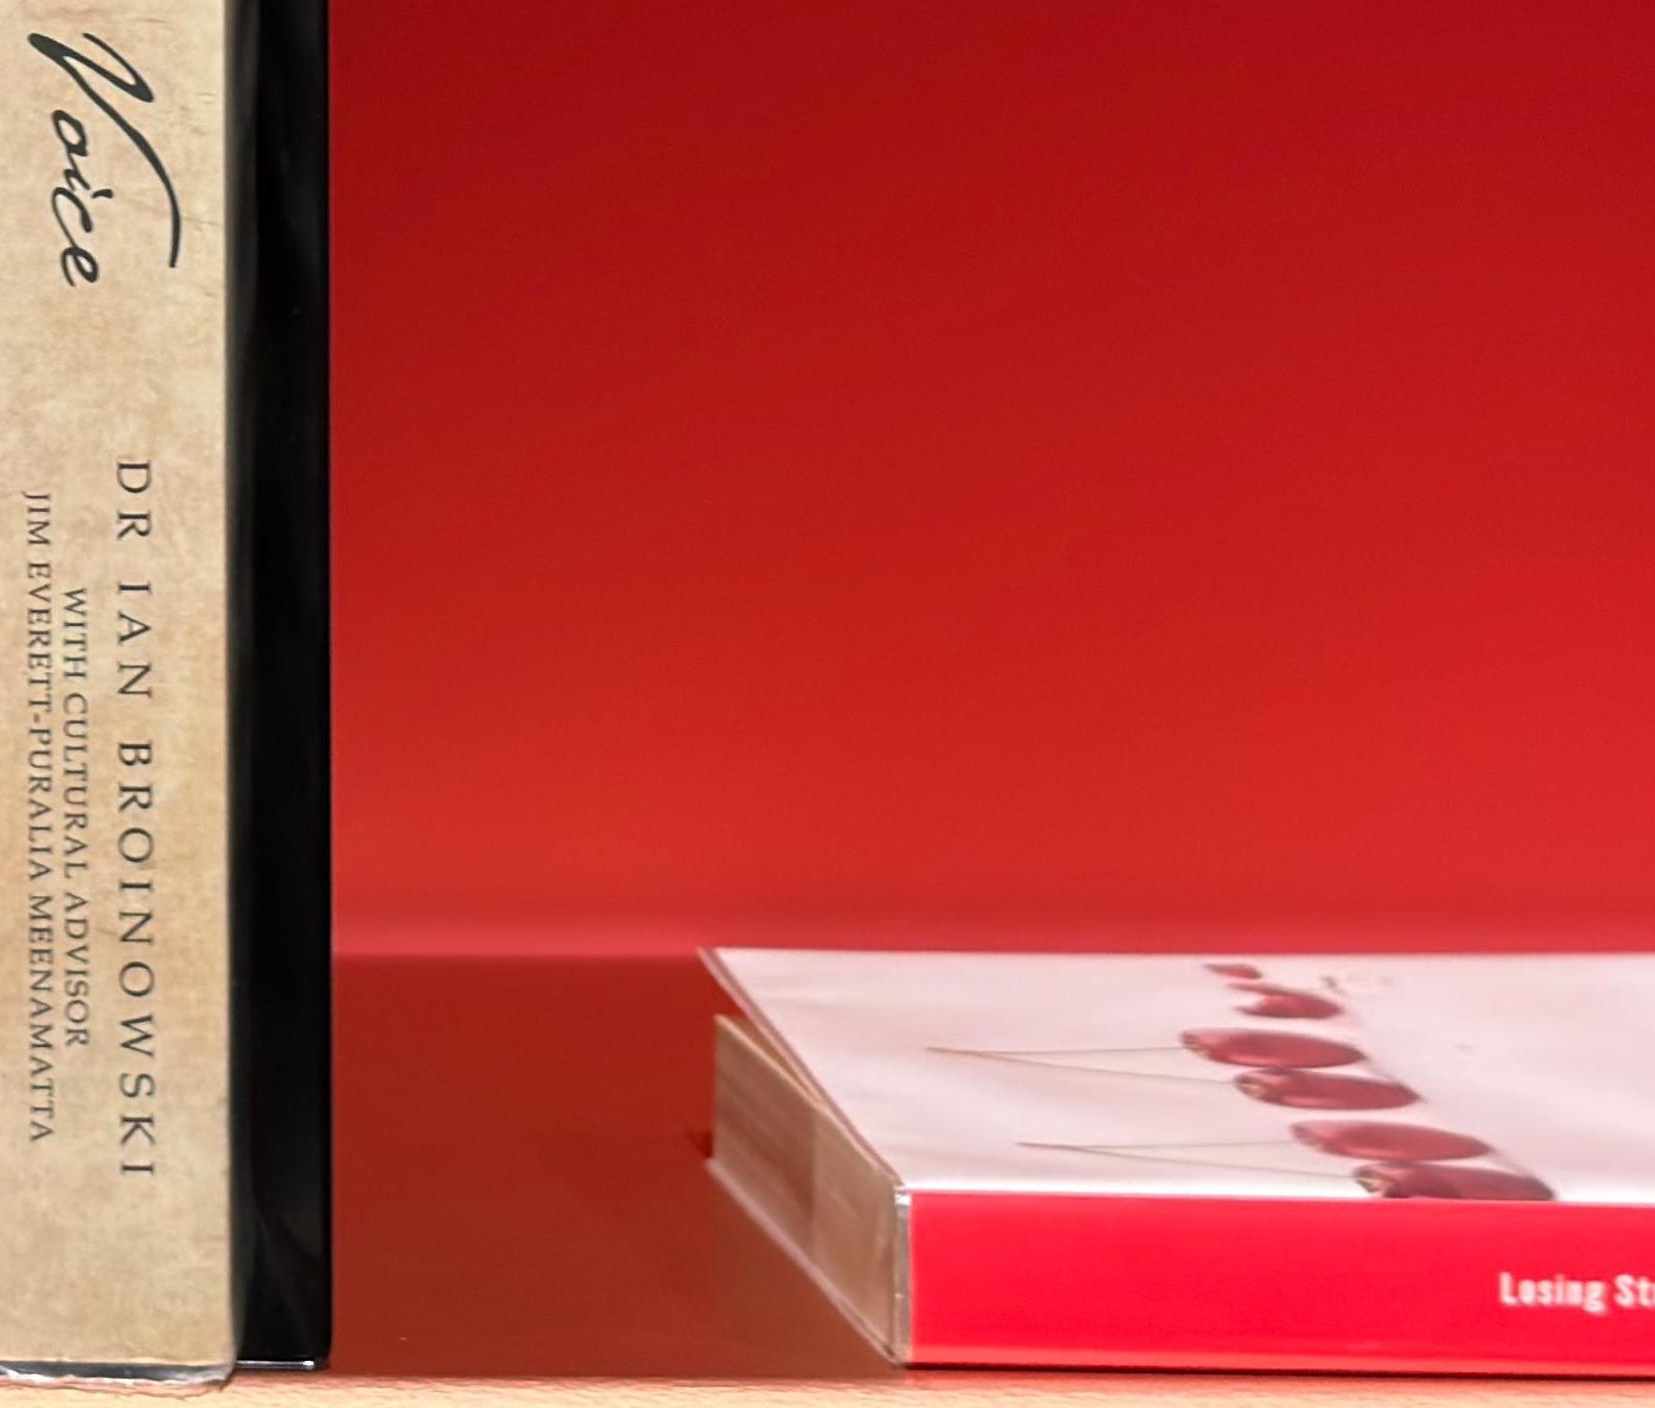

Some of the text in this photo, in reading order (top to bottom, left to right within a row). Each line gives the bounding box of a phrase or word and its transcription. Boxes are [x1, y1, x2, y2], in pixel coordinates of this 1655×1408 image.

[27, 31, 182, 287] Voice
[21, 490, 54, 1142] JIM EVERETT-PURALIA MEENAMATTA
[63, 588, 89, 1047] WITH CULTURAL ADVISOR
[116, 460, 155, 1176] DR IAN BROINOWSKI
[1498, 1272, 1609, 1316] Losing
